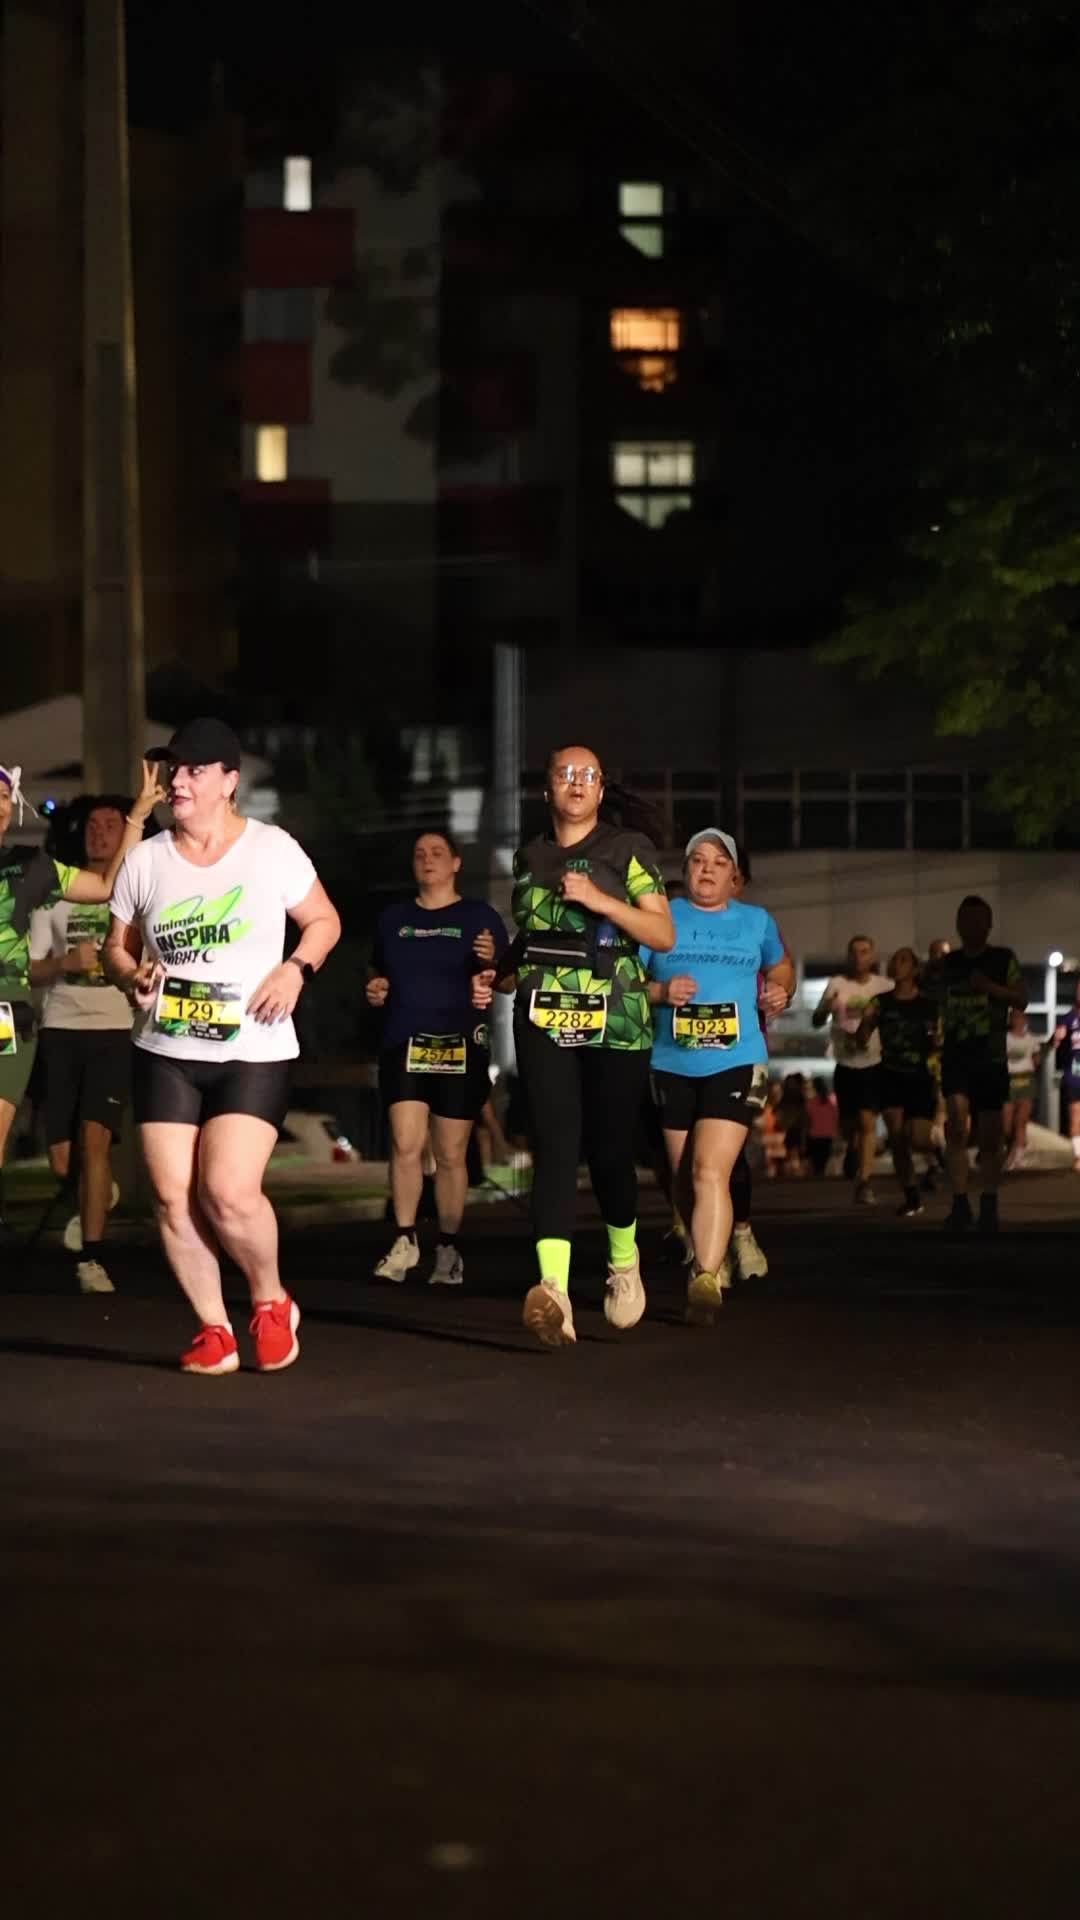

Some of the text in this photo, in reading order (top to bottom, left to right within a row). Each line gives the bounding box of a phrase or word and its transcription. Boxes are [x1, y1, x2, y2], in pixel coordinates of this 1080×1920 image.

[153, 913, 204, 934] Unimed
[155, 924, 230, 952] INSPIRA
[545, 1010, 594, 1028] 2282
[687, 1020, 727, 1034] 1923
[419, 1047, 455, 1060] 2571
